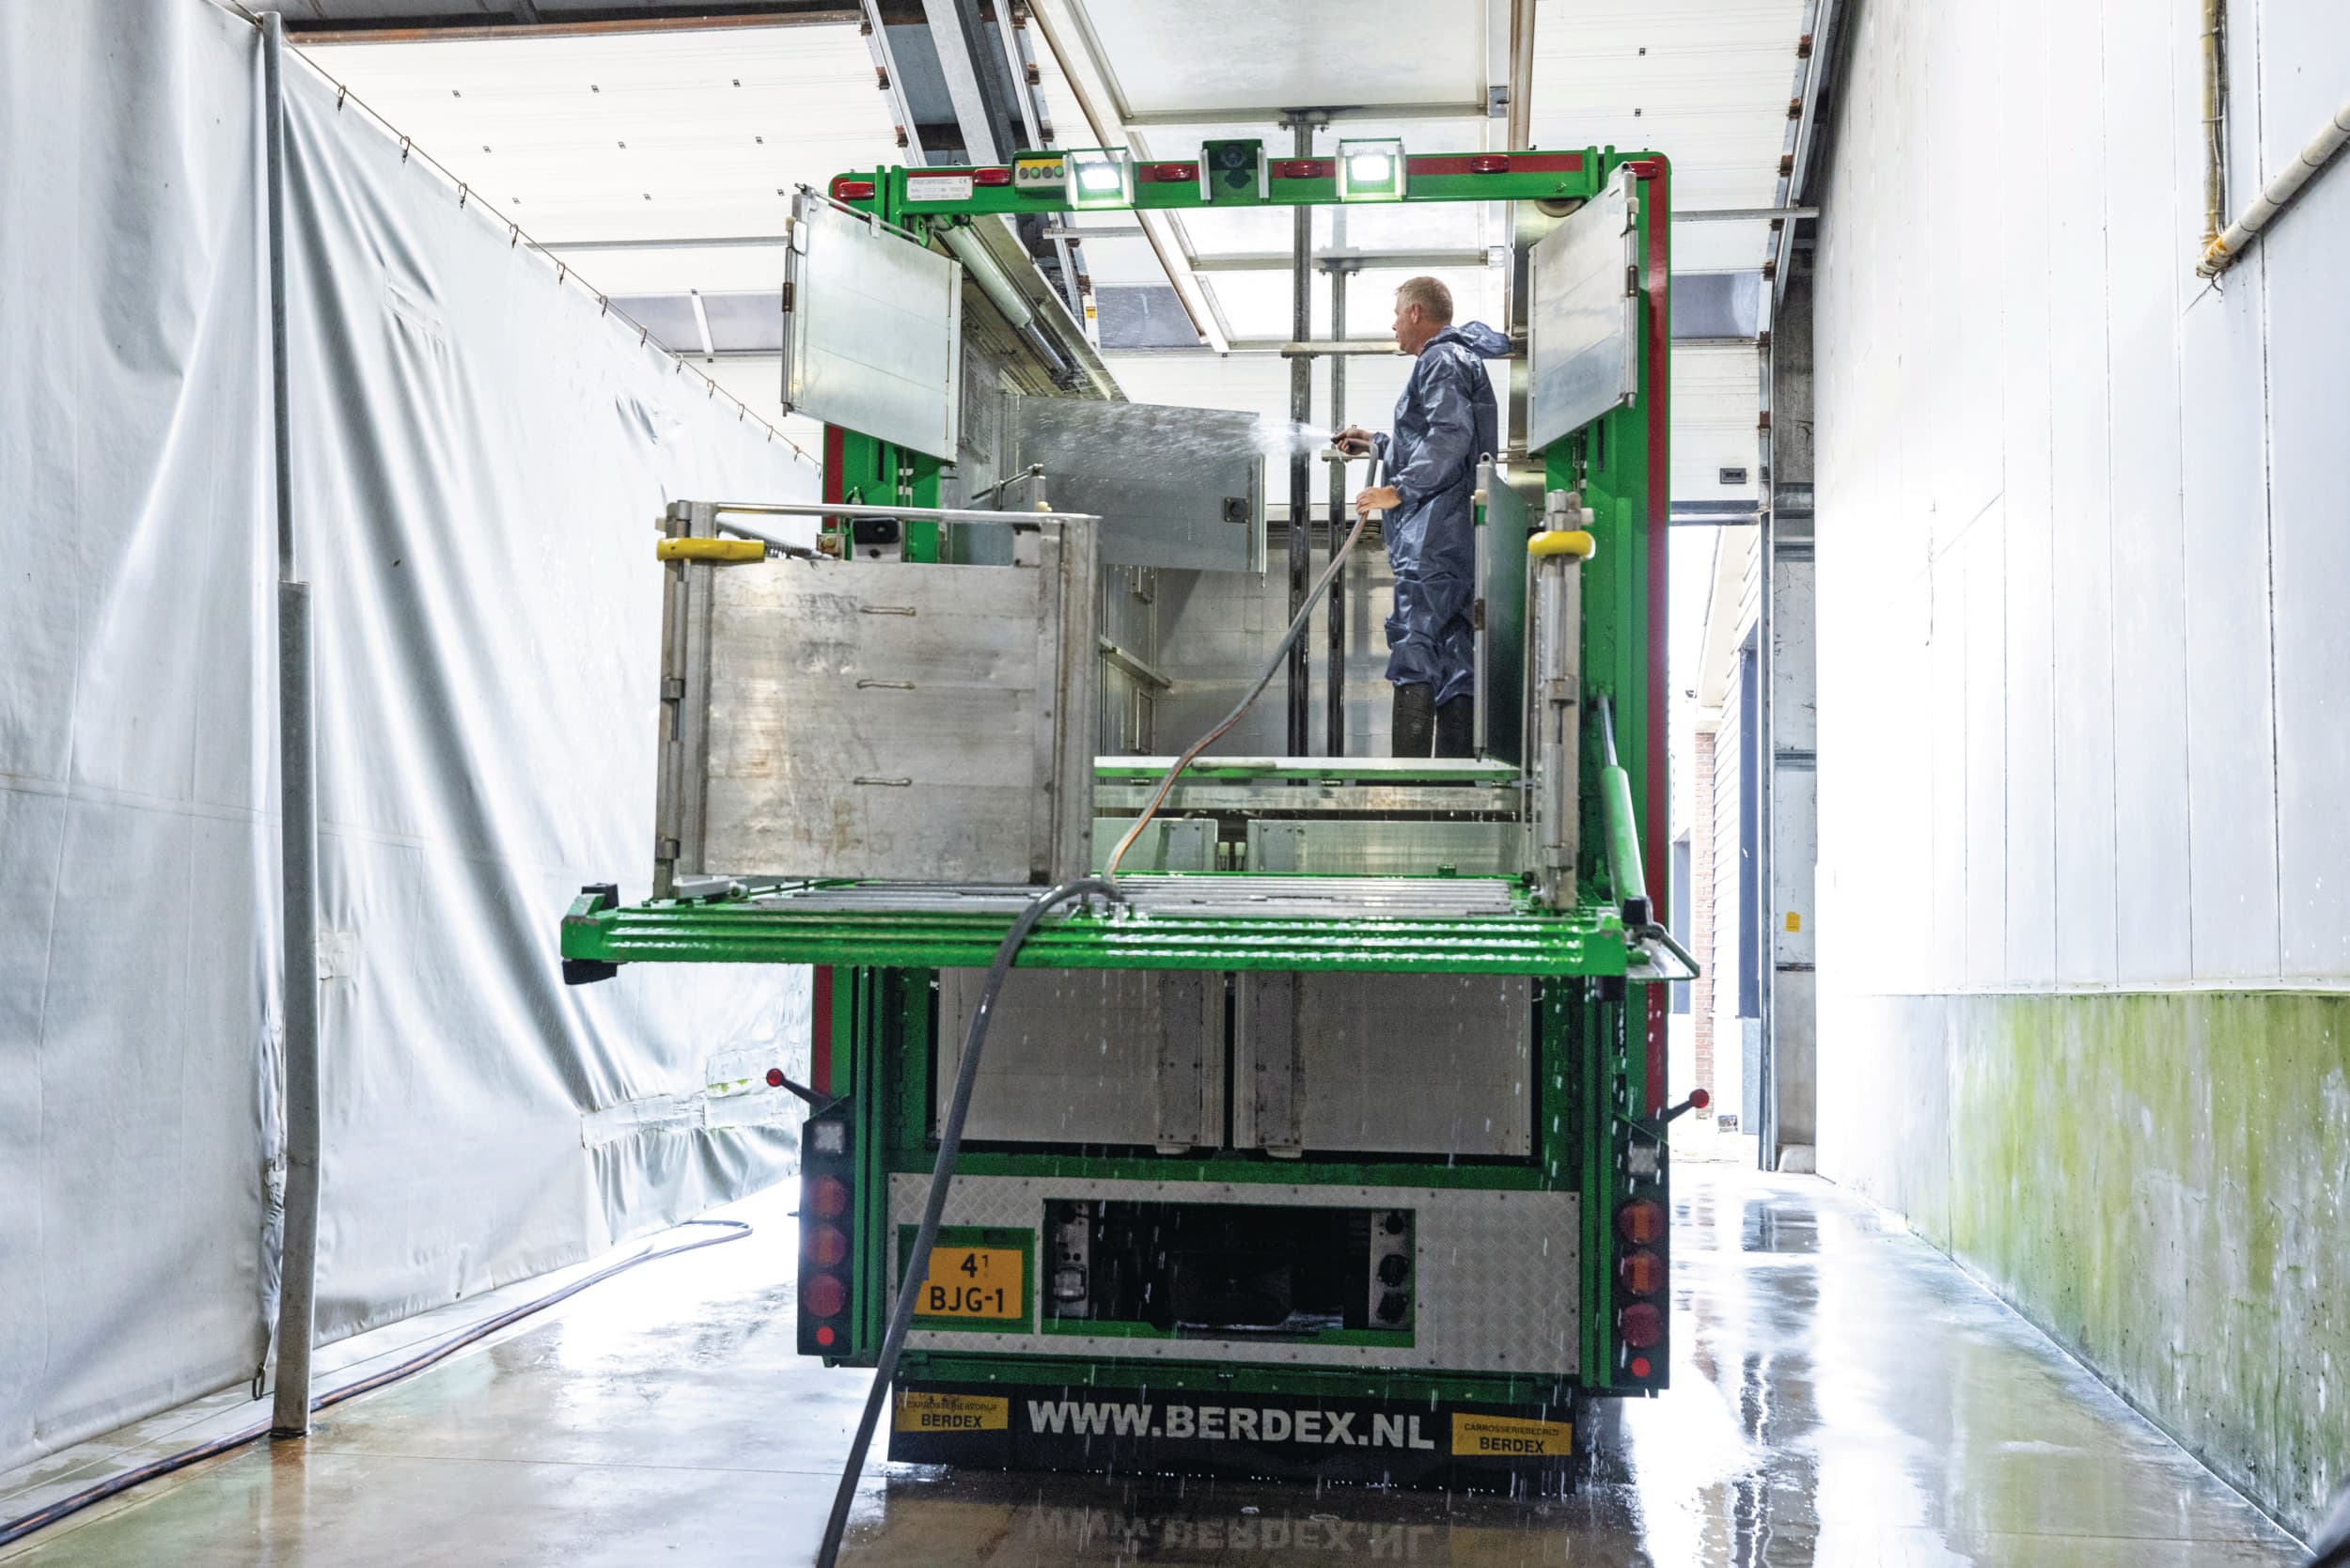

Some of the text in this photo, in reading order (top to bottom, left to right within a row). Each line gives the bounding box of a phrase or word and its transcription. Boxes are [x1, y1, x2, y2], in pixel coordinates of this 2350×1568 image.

[931, 1286, 1003, 1313] BJG-1
[922, 1413, 982, 1428] BERDEX
[1027, 1400, 1435, 1450] WWW.BERDEX.NL
[1480, 1436, 1544, 1453] BERDEX
